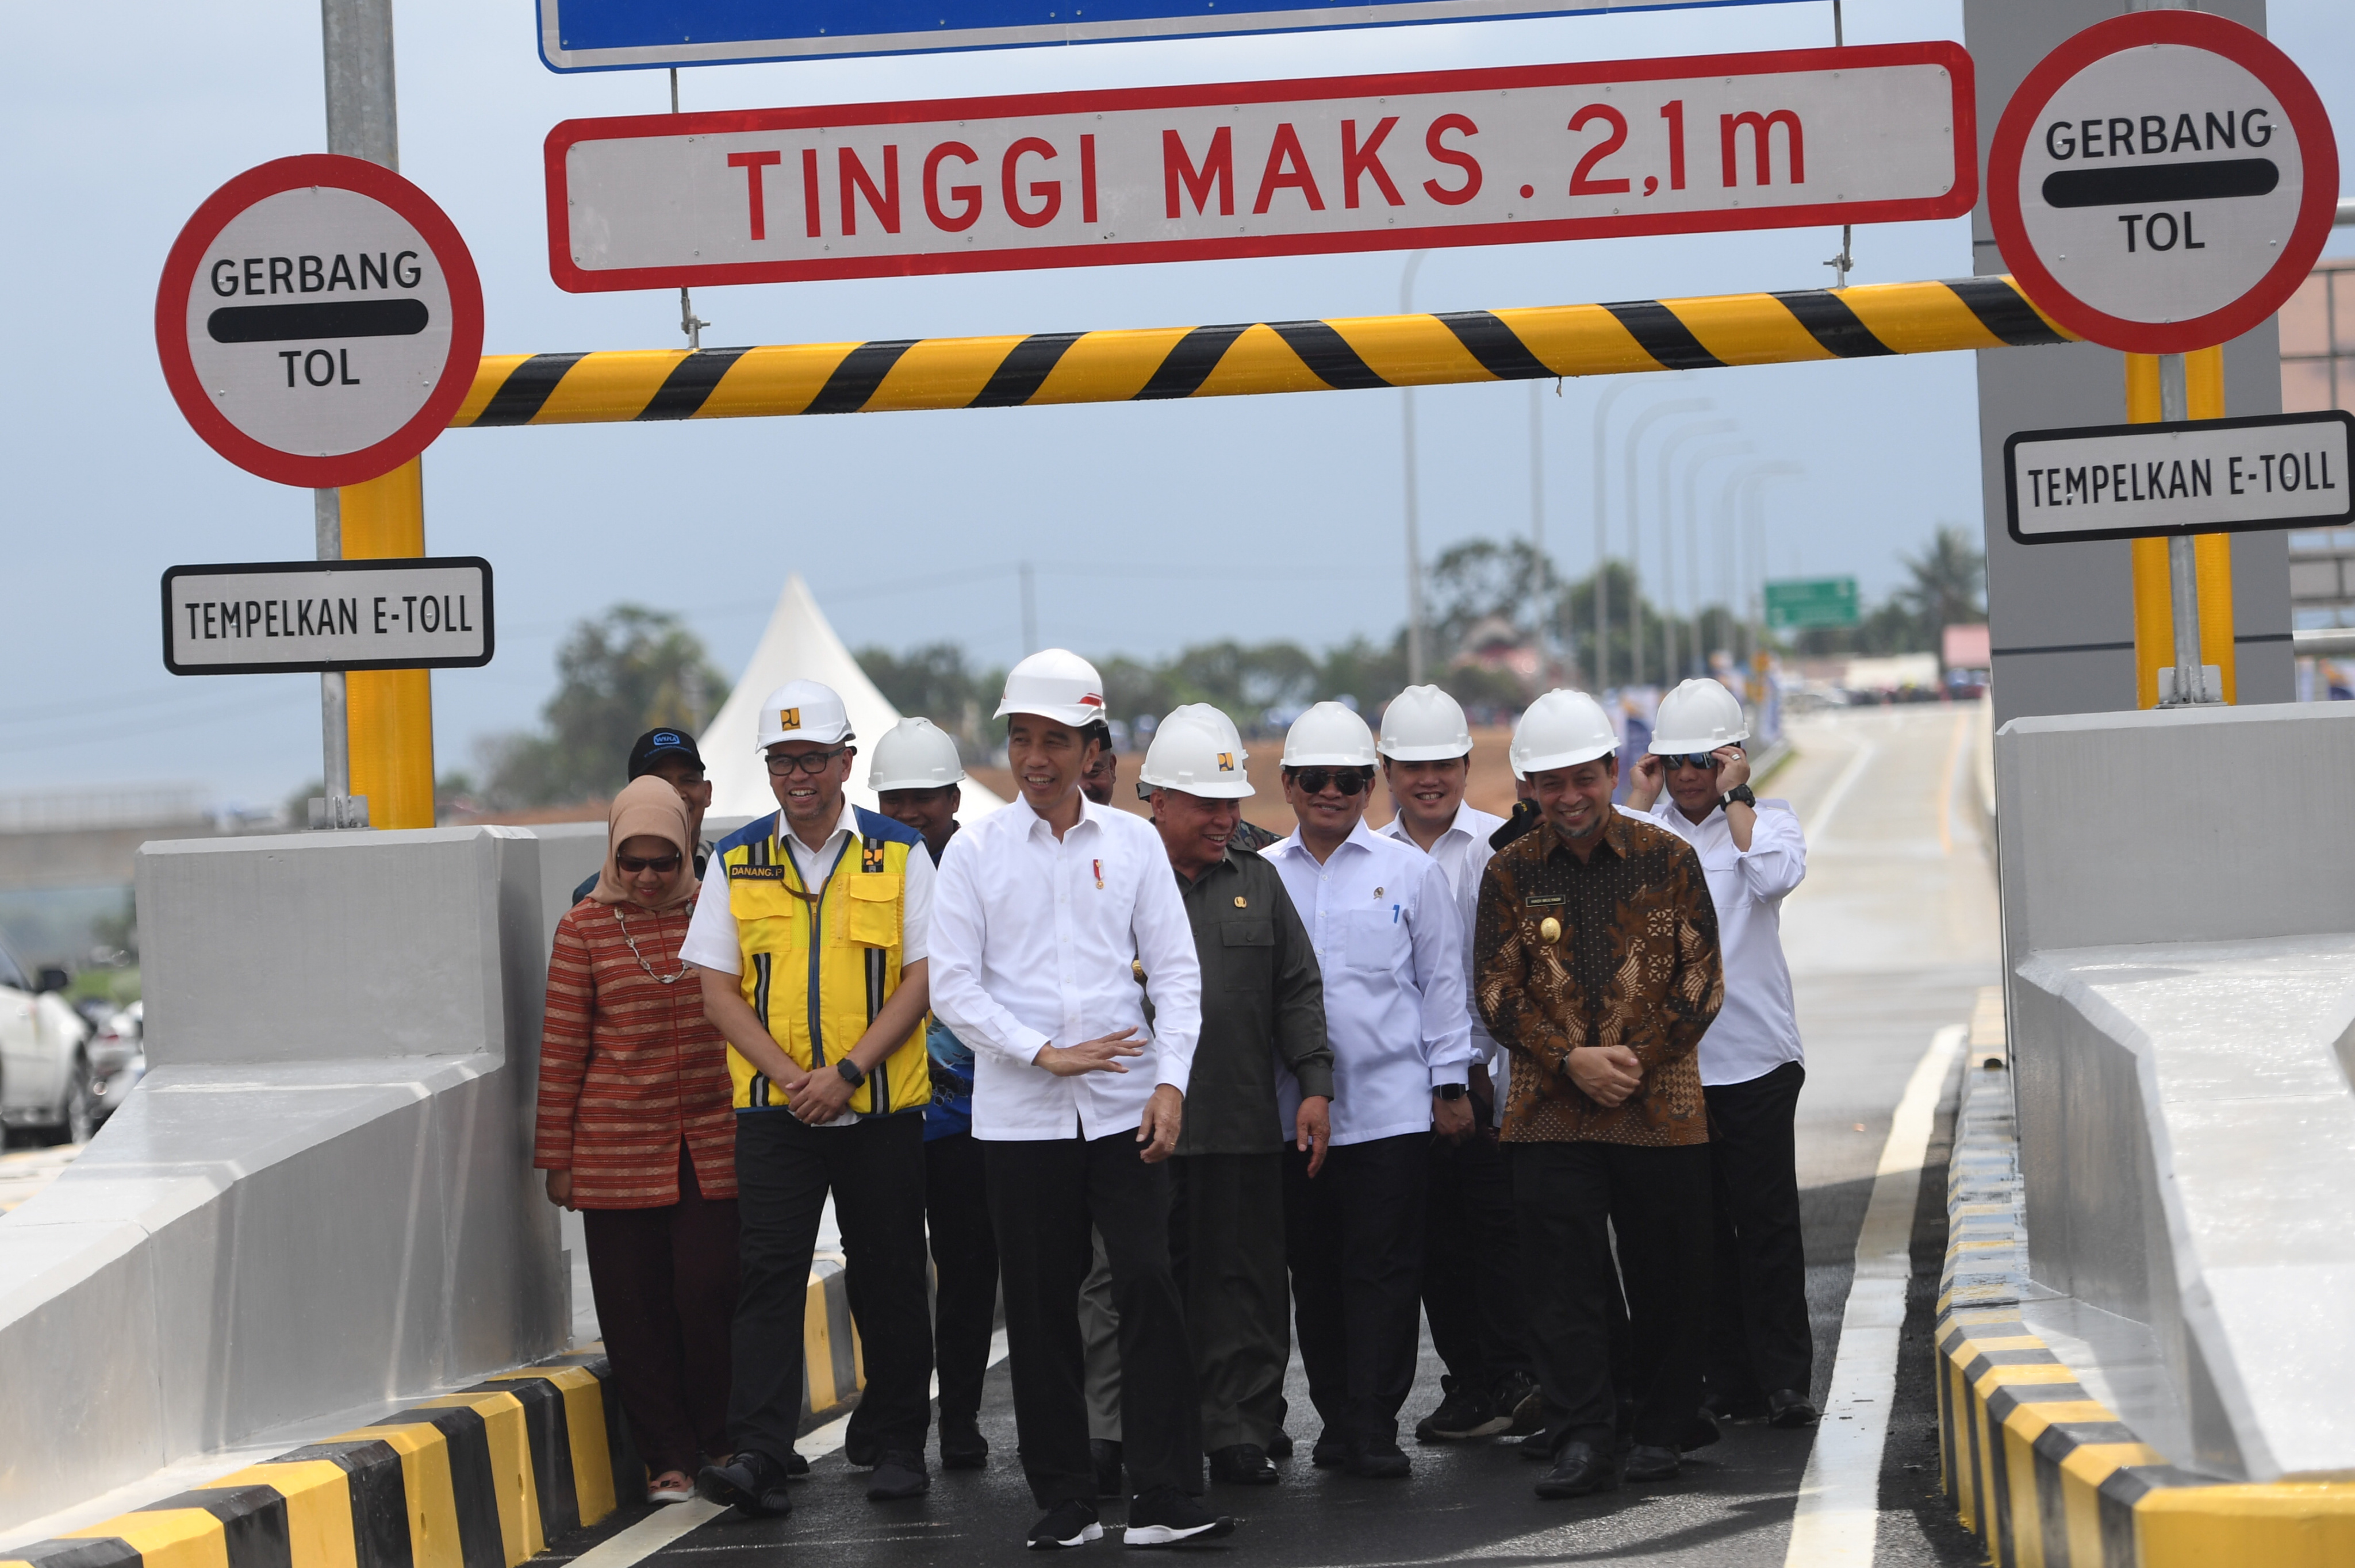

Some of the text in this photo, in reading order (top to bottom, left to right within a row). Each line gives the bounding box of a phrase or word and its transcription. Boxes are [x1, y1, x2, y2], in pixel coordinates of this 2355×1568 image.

[2045, 108, 2272, 160] GERBANG
[727, 134, 1098, 240] TINGGI
[2118, 211, 2206, 253] TOL
[210, 251, 421, 297] GERBANG
[279, 348, 360, 387] TOL
[2028, 451, 2335, 508] TEMPELKAN E-TOLL
[185, 595, 472, 640] TEMPELKAN E-TOLL
[731, 867, 774, 877] DANANG.
